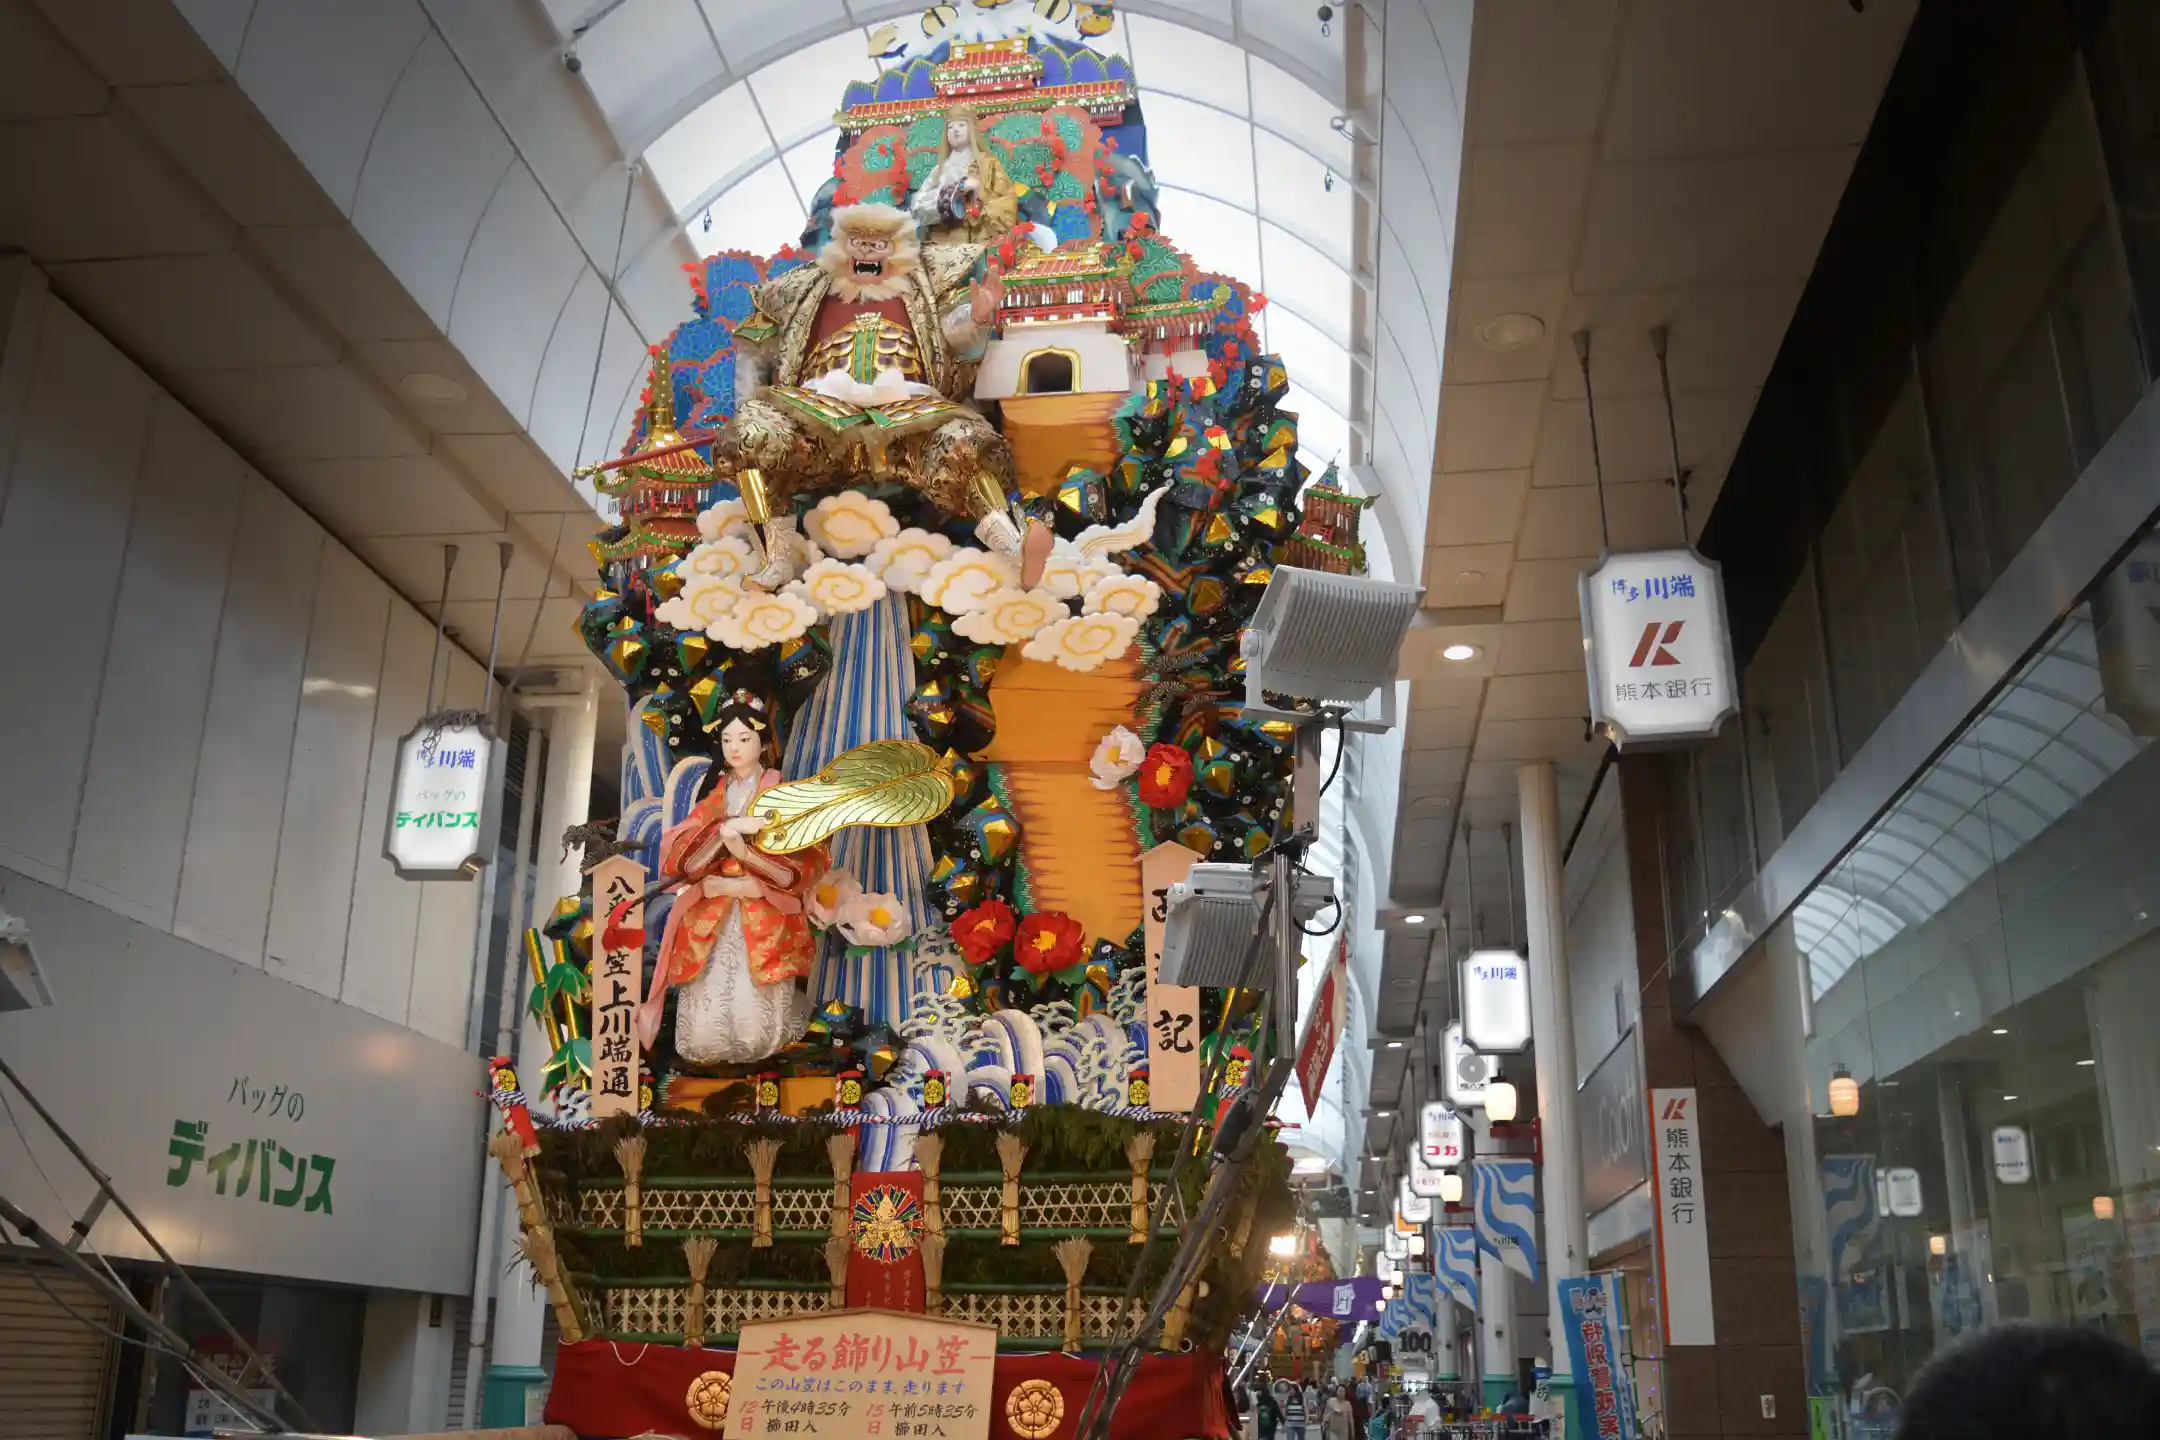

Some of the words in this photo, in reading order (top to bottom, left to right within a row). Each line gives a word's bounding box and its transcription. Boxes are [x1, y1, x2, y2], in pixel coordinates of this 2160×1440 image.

[1612, 574, 1695, 602] 博多川端
[1615, 677, 1713, 702] 熊本銀行
[396, 811, 479, 828] ディバンス
[599, 875, 636, 1098] 八笠上川端通
[227, 1075, 304, 1122] バッグの
[166, 1119, 336, 1216] ディバンス
[1666, 1128, 1694, 1224] 熊本銀行
[1398, 1331, 1432, 1353] 100
